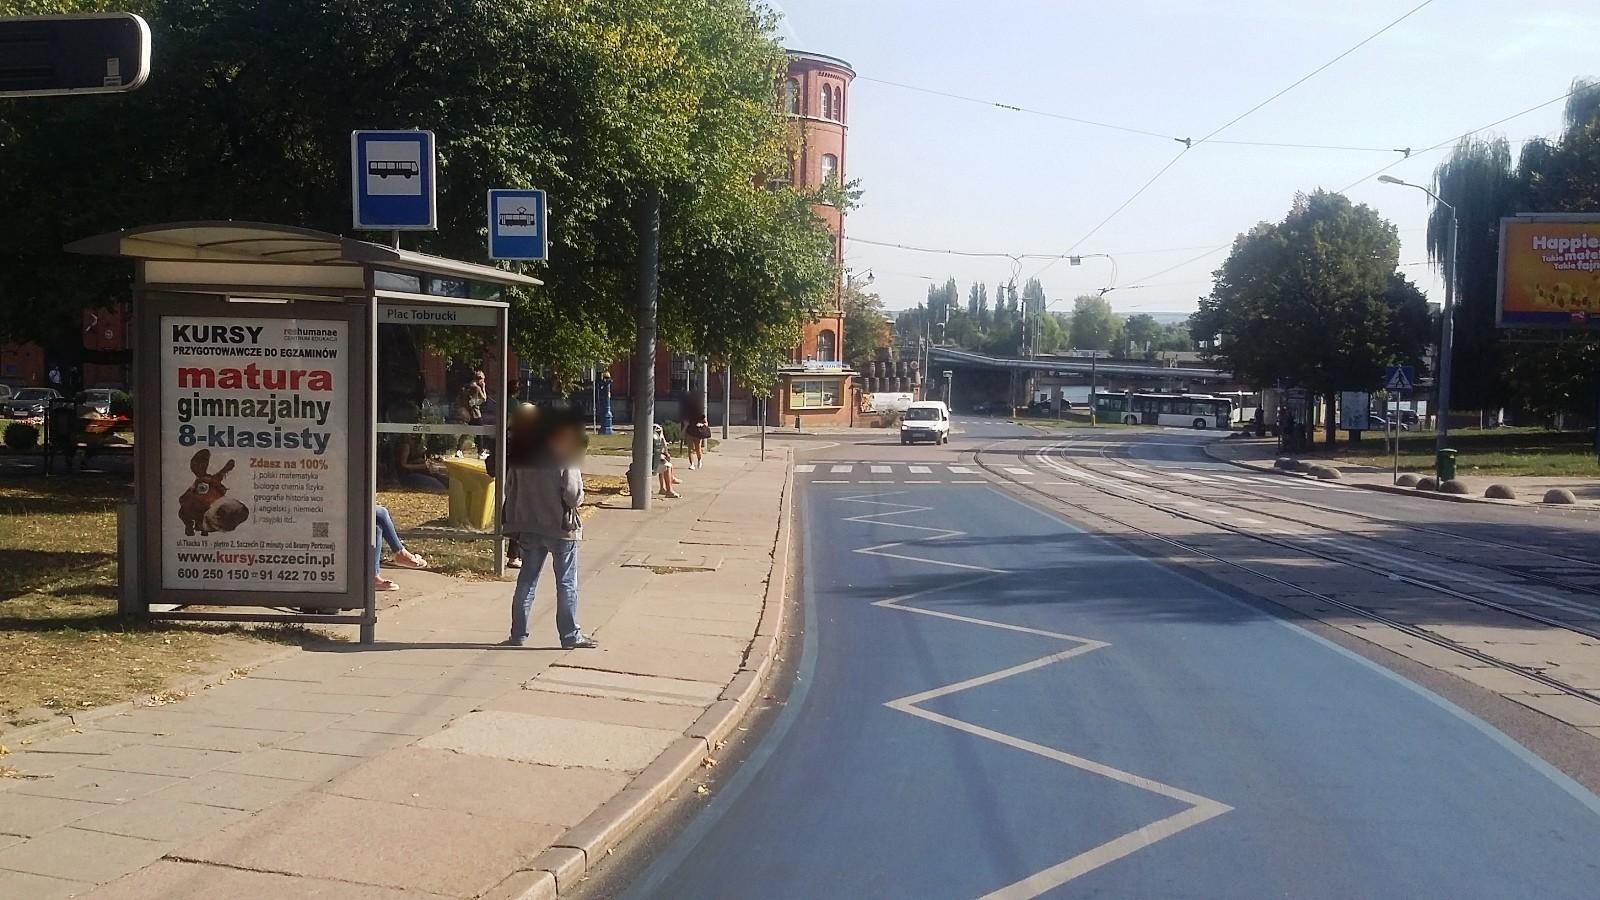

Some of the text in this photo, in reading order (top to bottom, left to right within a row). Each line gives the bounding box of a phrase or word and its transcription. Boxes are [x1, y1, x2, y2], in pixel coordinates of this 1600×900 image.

[1532, 234, 1600, 253] Happie
[1542, 254, 1563, 263] Takie
[1553, 262, 1576, 270] Takie
[387, 308, 457, 321] Plac Tobrucki
[172, 324, 264, 345] KURSY
[172, 345, 338, 359] PRZYGOTOWAWCZE DO EGZAMINÓW
[178, 362, 333, 391] matura
[177, 392, 331, 426] gimnazjalny
[178, 424, 331, 455] 8-klasisty
[249, 457, 329, 470] Zdasz na 100%
[279, 472, 319, 482] matematyka
[177, 550, 335, 568] www.kursy.szczecin.pl
[177, 568, 336, 581] 600 250 150 91 422 70 95
